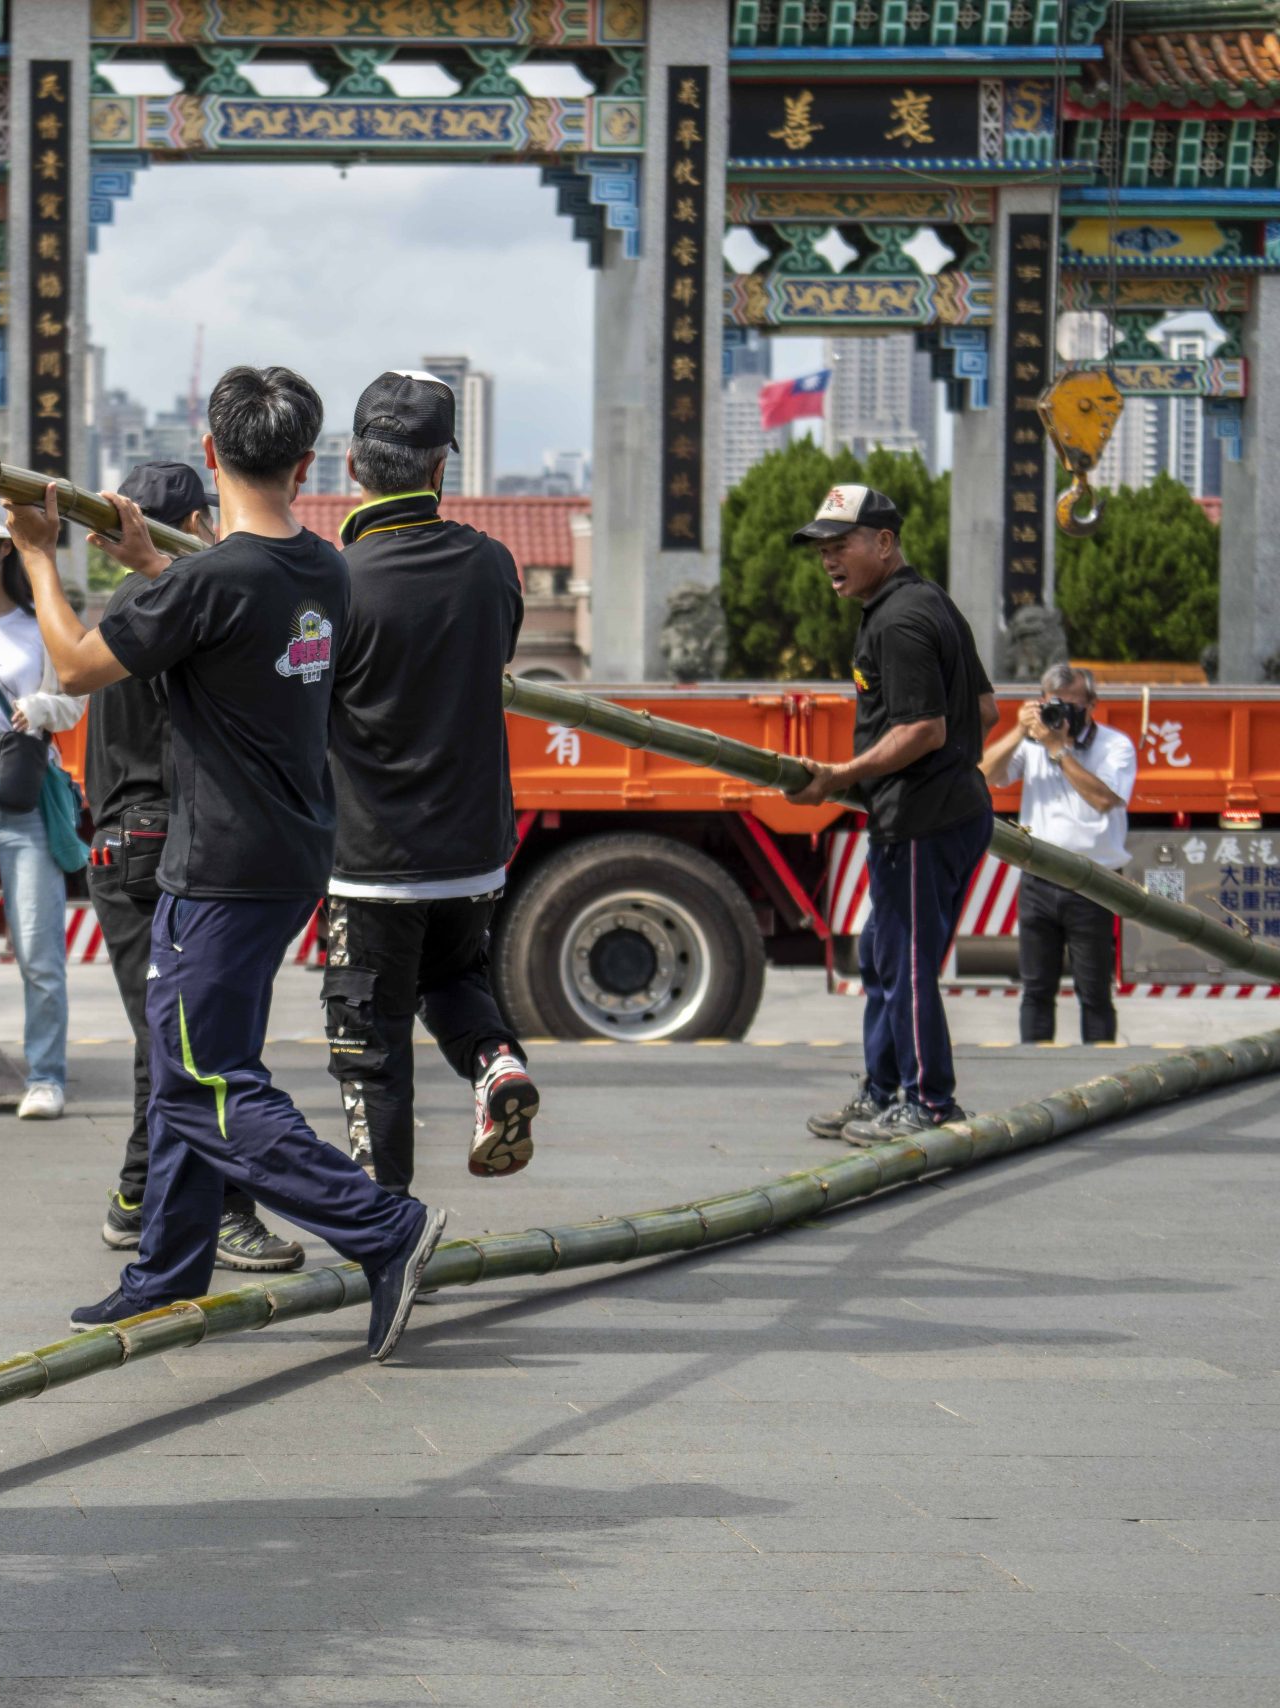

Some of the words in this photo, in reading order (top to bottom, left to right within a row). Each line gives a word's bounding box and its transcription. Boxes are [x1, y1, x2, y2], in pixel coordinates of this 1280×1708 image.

[545, 725, 580, 766] 有
[1145, 719, 1192, 767] 汽
[1182, 836, 1279, 865] 台展汽
